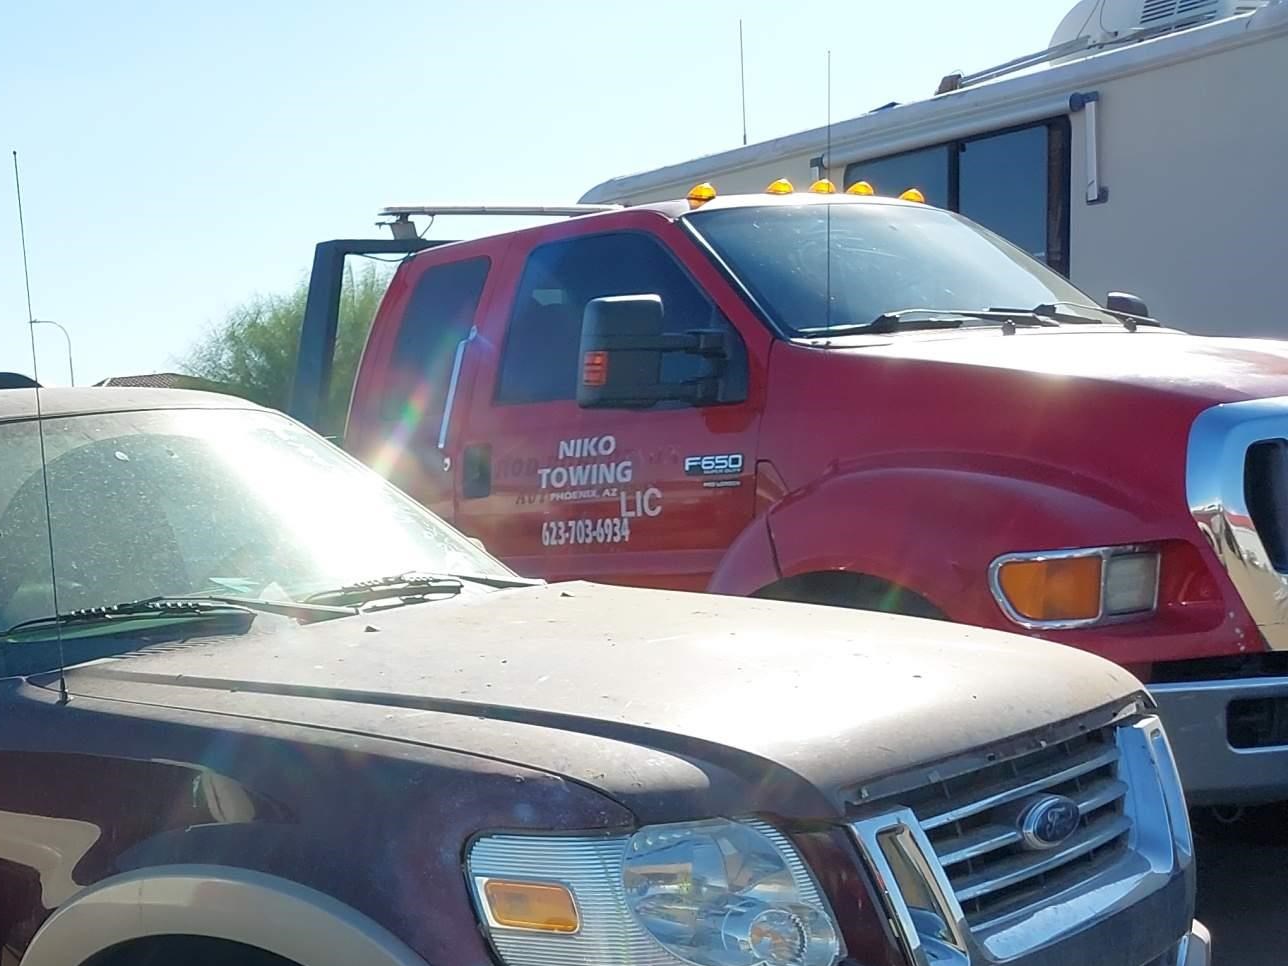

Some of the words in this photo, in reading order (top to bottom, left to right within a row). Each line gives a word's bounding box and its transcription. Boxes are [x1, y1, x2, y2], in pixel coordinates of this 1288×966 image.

[558, 435, 616, 460] NIKO
[538, 461, 633, 489] TOWING
[602, 488, 618, 498] AZ
[620, 487, 663, 518] LIC
[542, 518, 630, 546] 623-703-6934
